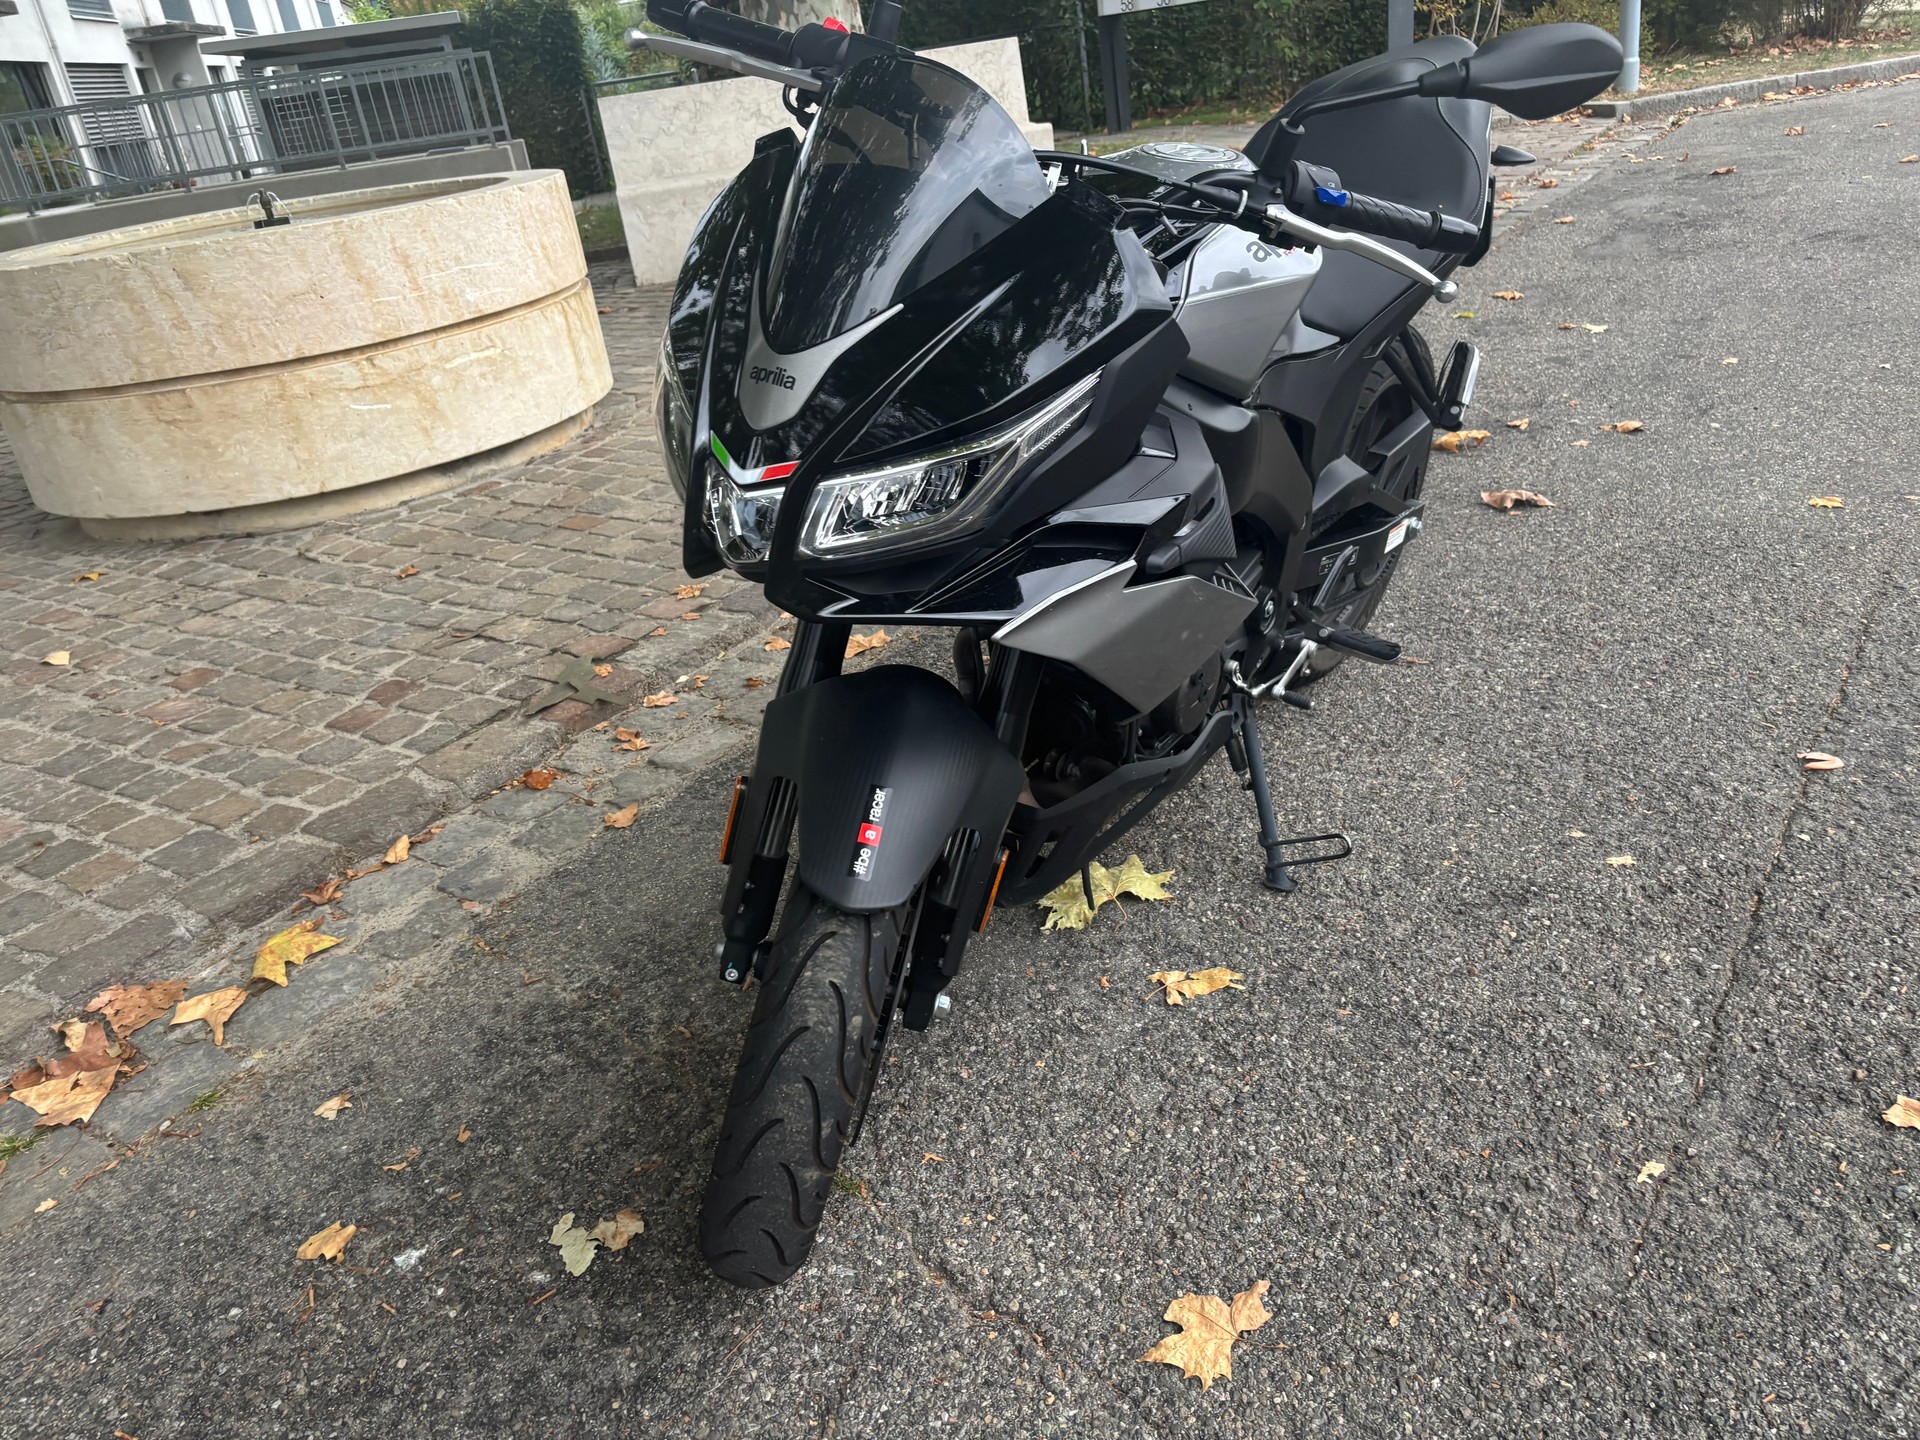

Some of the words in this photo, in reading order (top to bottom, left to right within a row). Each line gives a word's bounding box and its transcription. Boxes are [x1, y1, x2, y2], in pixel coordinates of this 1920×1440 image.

[750, 366, 796, 391] aprilia
[869, 787, 887, 822] racer
[864, 829, 877, 840] a
[853, 847, 872, 875] #be
